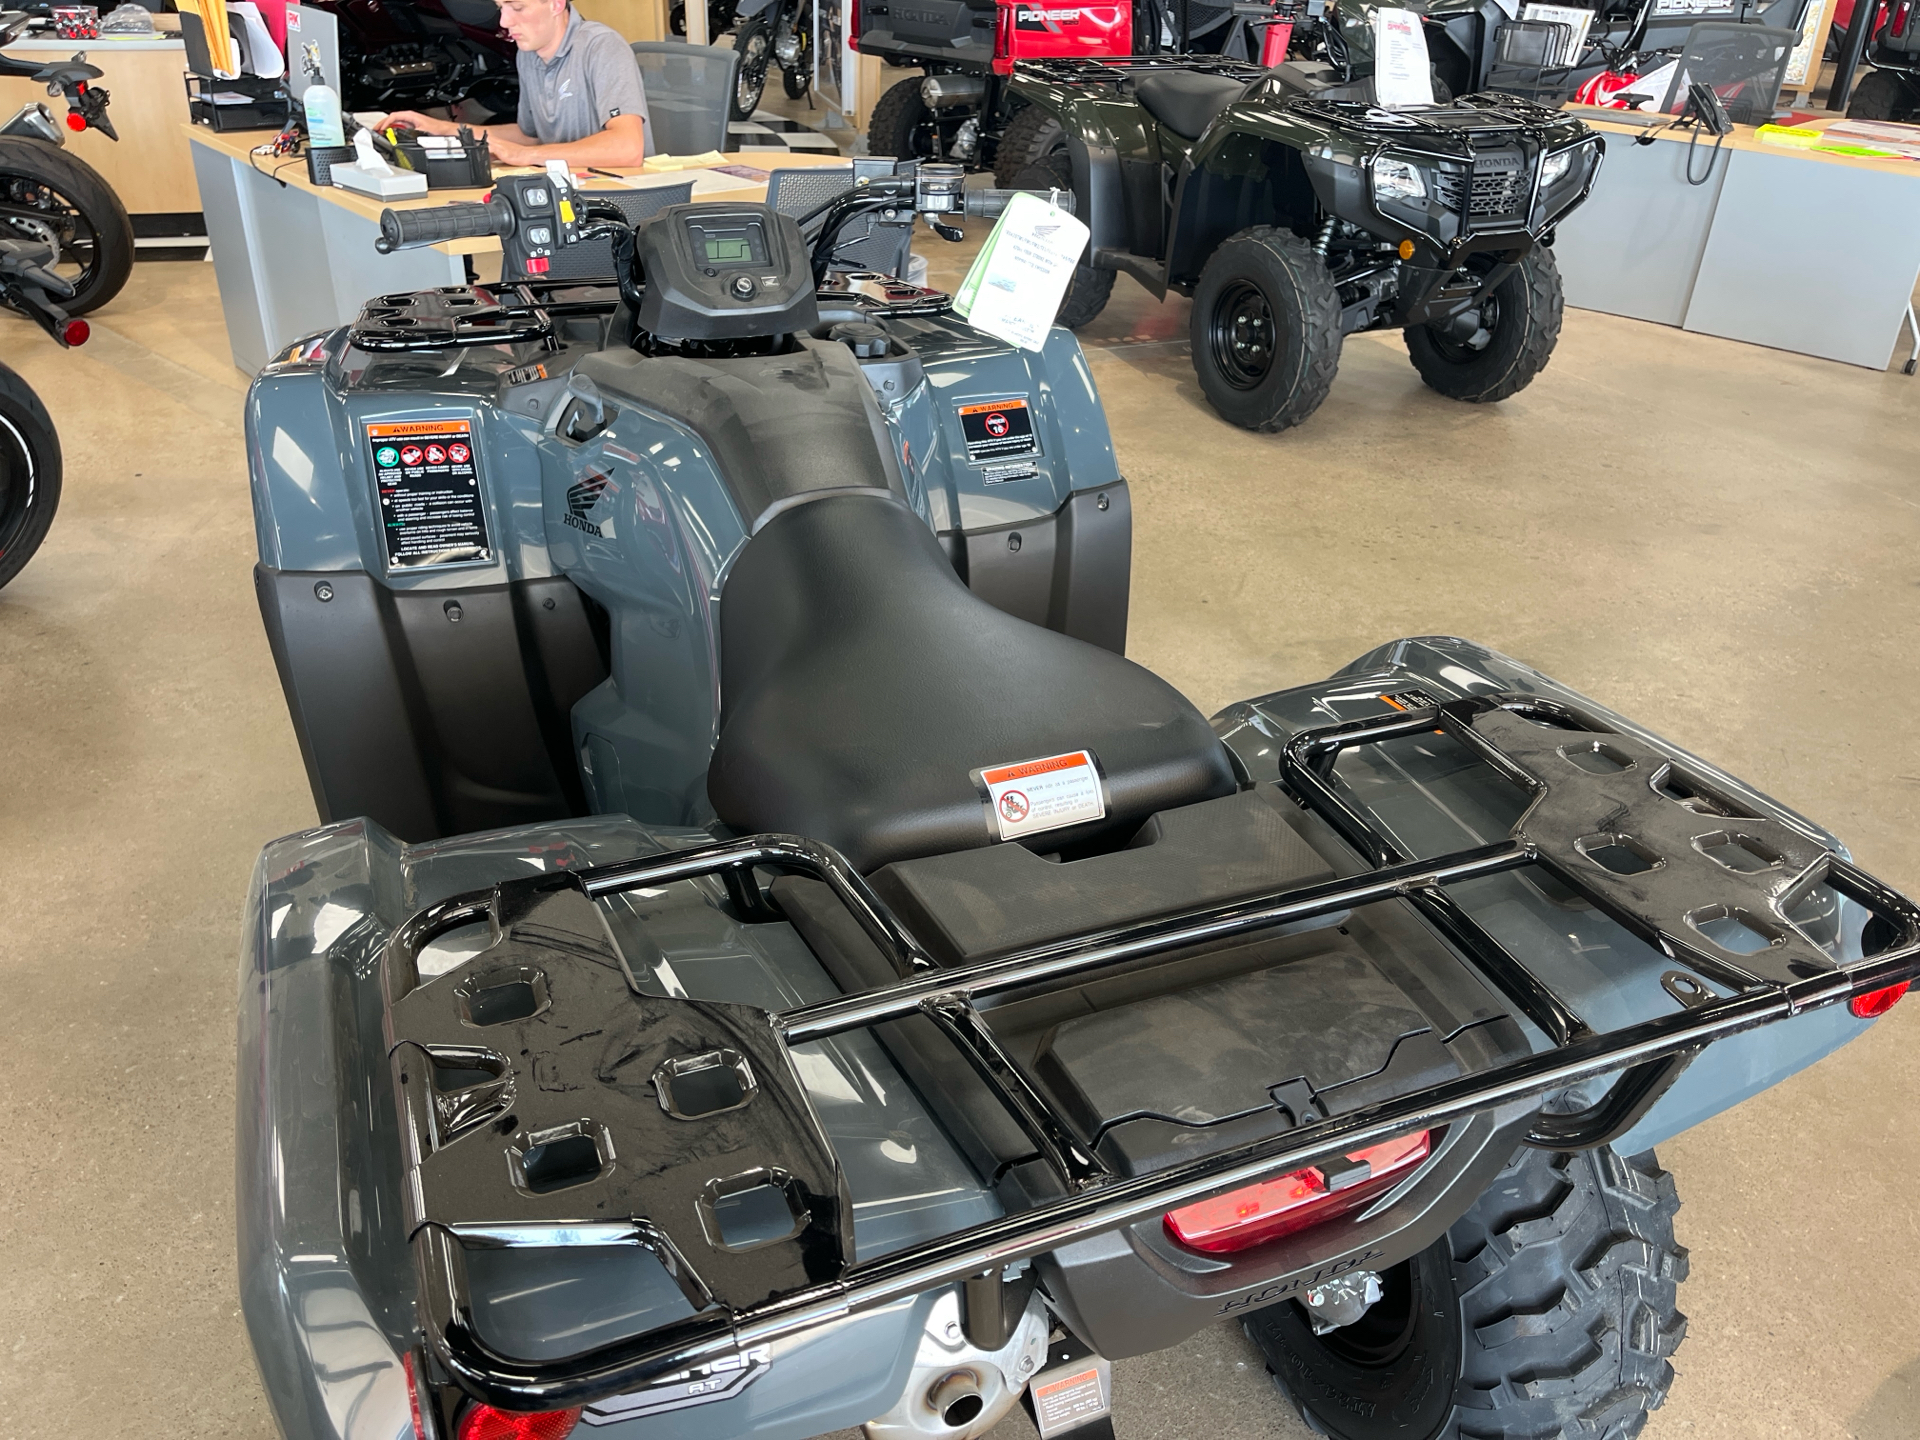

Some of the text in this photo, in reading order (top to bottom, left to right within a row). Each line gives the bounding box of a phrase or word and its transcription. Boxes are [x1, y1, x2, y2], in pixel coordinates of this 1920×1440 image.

[1018, 9, 1080, 22] PIONEER
[1475, 158, 1520, 168] HONDA
[980, 403, 1013, 412] WARNING
[400, 424, 444, 433] WARNING
[563, 513, 603, 538] HONDA
[1018, 759, 1068, 775] WARNING
[1026, 784, 1044, 793] NEVER
[1032, 811, 1051, 819] SEVERE
[1053, 807, 1070, 816] INJURY
[688, 1378, 722, 1395] AT
[1052, 1373, 1088, 1390] WARNING
